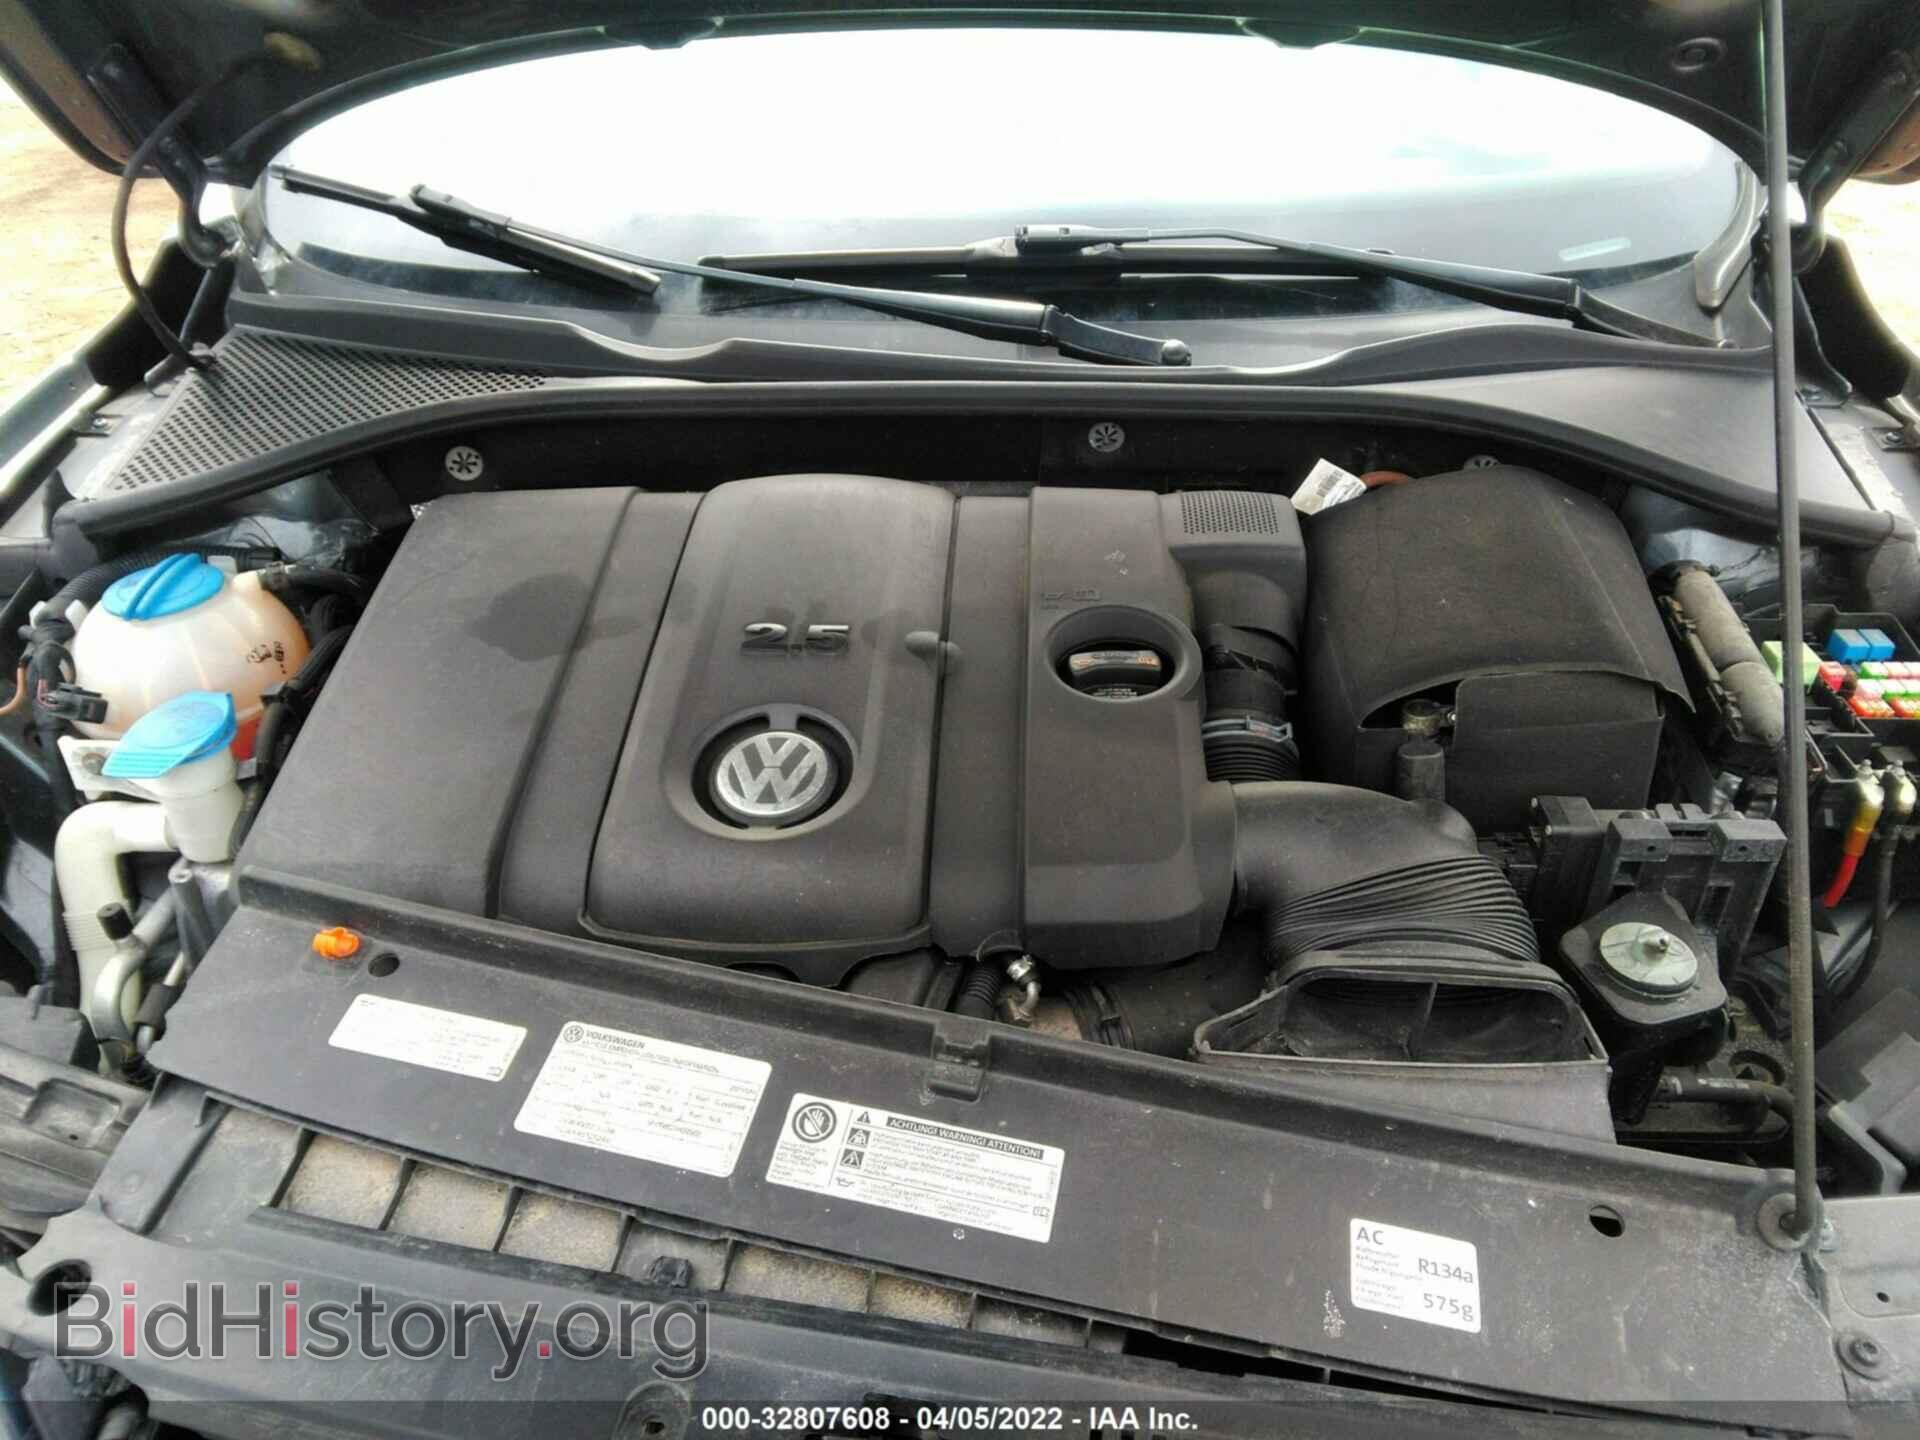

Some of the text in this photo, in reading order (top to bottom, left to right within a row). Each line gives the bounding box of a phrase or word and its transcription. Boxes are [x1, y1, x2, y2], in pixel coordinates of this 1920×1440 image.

[741, 623, 849, 652] 2.5
[586, 1030, 645, 1049] VOLKSWAGEN
[889, 1119, 1042, 1159] ACHTUNG! WARNING! ATTENTION!
[1356, 1227, 1384, 1245] AC
[1418, 1258, 1473, 1284] R134a
[1423, 1293, 1474, 1322] 575g
